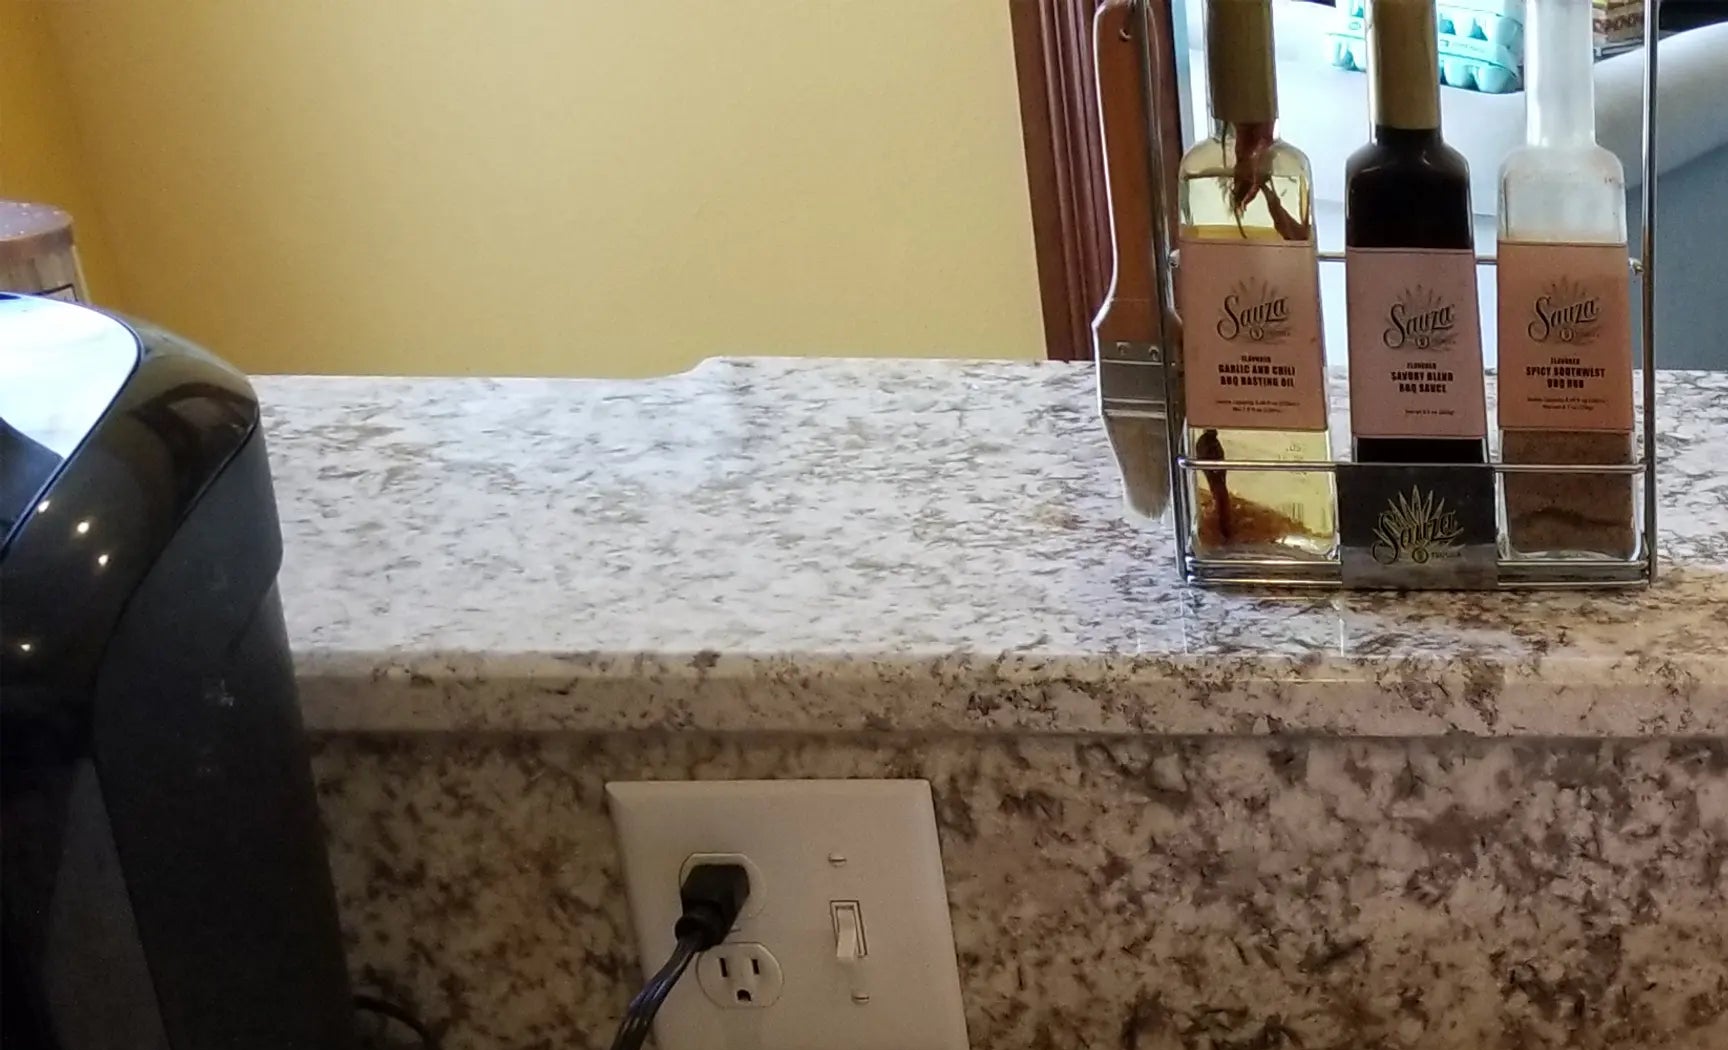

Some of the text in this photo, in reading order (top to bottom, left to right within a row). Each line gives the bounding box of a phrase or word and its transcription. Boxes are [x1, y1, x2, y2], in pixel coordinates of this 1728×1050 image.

[1217, 295, 1289, 341] Sauza
[1527, 296, 1599, 342] Sauza
[1383, 303, 1455, 349] Sauza
[1218, 364, 1296, 377] GARLIC AND CHILI
[1391, 371, 1454, 382] SAVORY BLEND
[1526, 366, 1606, 378] SPICY SOUTHWEST
[1220, 376, 1295, 388] BBQ BASTING OIL
[1399, 383, 1447, 393] BBQ SAUCE
[1371, 510, 1458, 565] Sauza
